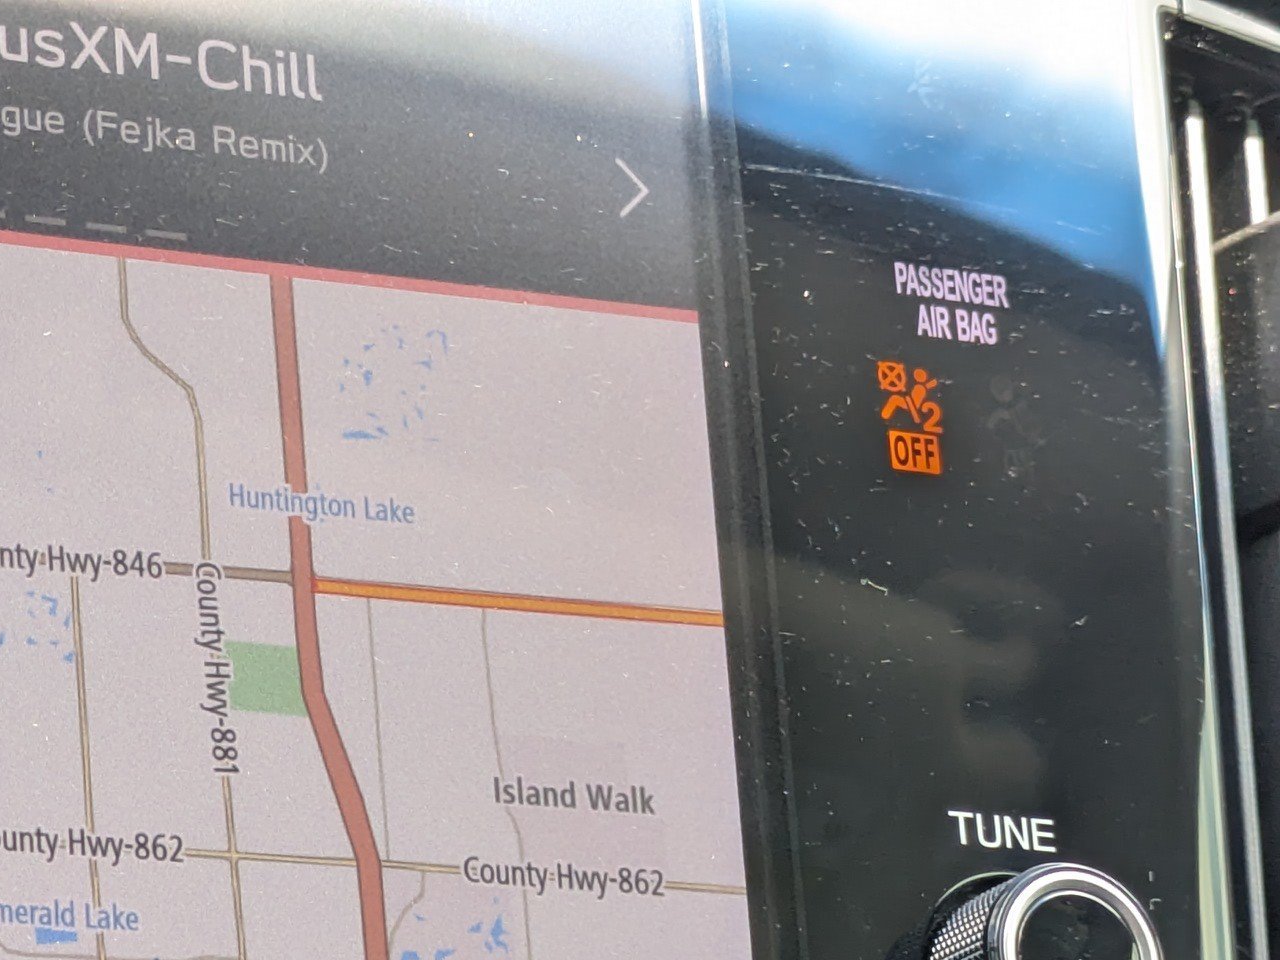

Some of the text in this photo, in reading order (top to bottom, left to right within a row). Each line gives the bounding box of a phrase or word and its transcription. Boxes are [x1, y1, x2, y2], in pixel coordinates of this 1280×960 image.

[83, 109, 197, 153] (Fejka
[212, 124, 329, 175] Remix)
[893, 260, 1009, 309] PASSENGER
[916, 304, 998, 346] AIR BAG
[893, 434, 935, 470] OFF
[228, 483, 415, 525] Huntington Lake
[47, 543, 164, 582] Hwy-846
[194, 561, 241, 776] County Hwy-881
[493, 776, 656, 816] Island Walk
[68, 828, 186, 867] Hwy-862
[947, 809, 1058, 853] TUNE
[463, 855, 666, 900] County Hwy-862
[84, 903, 140, 932] Lake
